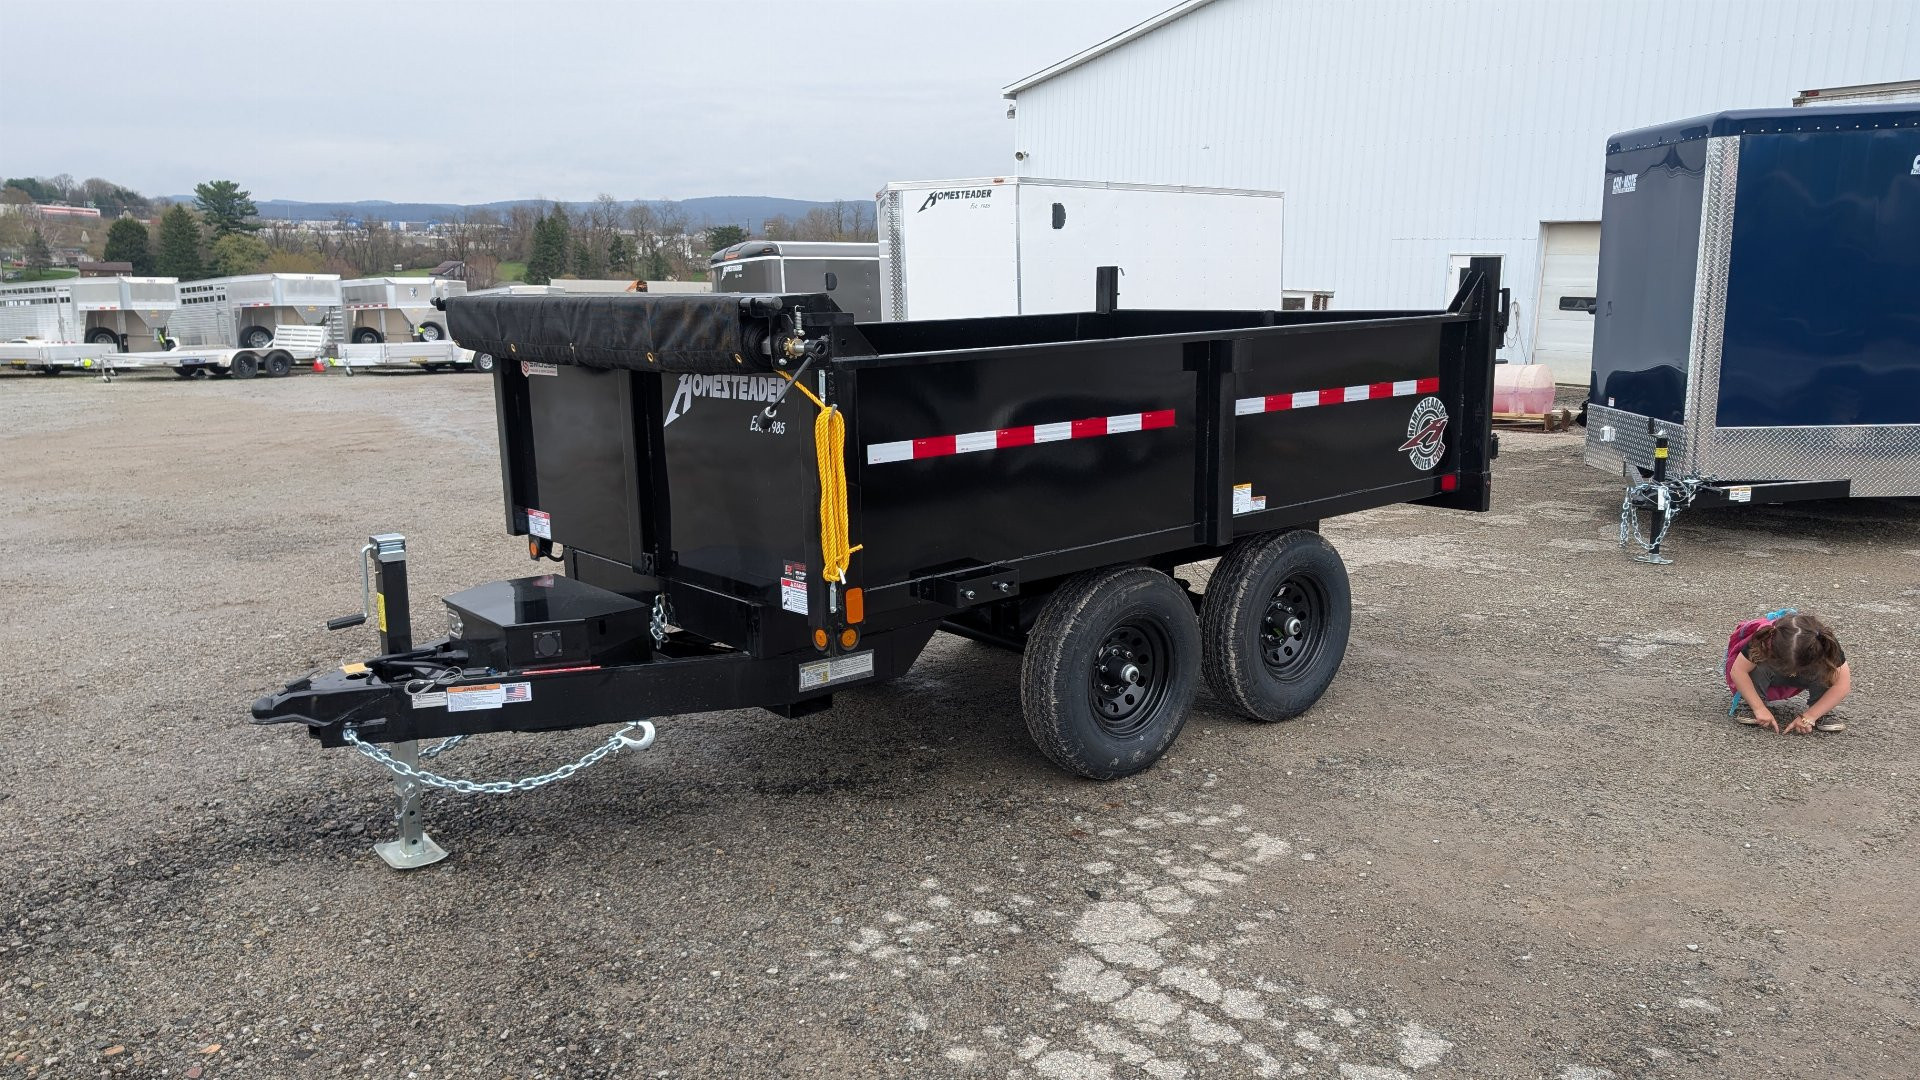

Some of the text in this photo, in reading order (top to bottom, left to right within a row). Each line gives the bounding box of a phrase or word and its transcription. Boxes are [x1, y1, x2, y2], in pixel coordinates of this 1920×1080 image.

[917, 190, 992, 213] HOMESTEADER
[664, 374, 786, 428] HOMESTEADER
[1408, 397, 1447, 437] HOMESTEADER
